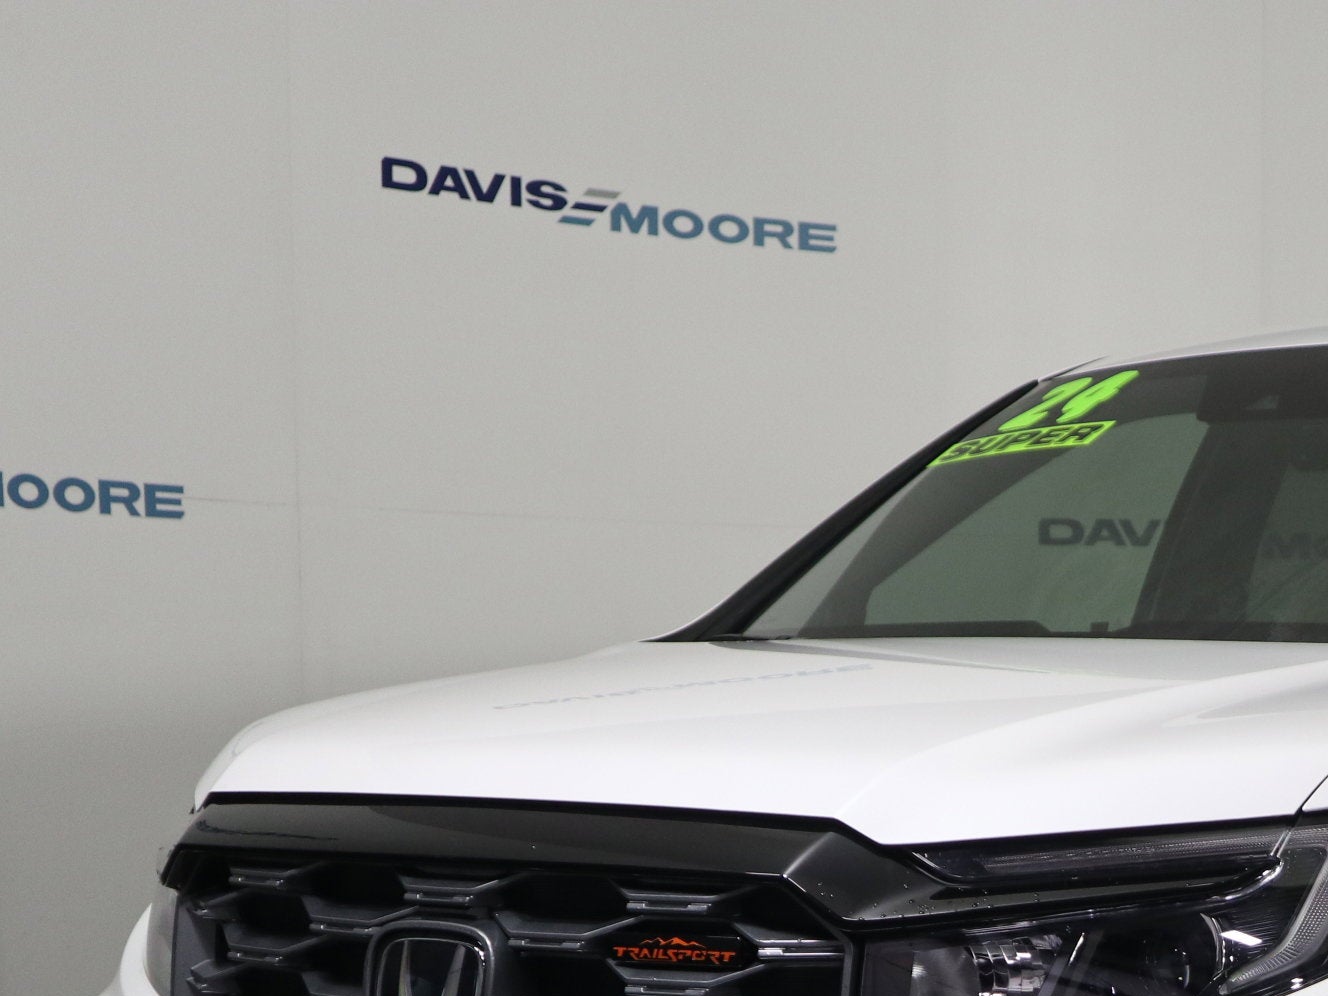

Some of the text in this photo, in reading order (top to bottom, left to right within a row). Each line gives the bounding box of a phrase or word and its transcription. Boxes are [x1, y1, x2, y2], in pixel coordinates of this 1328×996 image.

[381, 156, 837, 253] DAVIS MOORE
[998, 370, 1139, 432] 24
[938, 423, 1106, 462] SUPER
[0, 471, 185, 519] OORE
[1038, 517, 1162, 547] DAV
[613, 946, 736, 965] TRAILSPORT
